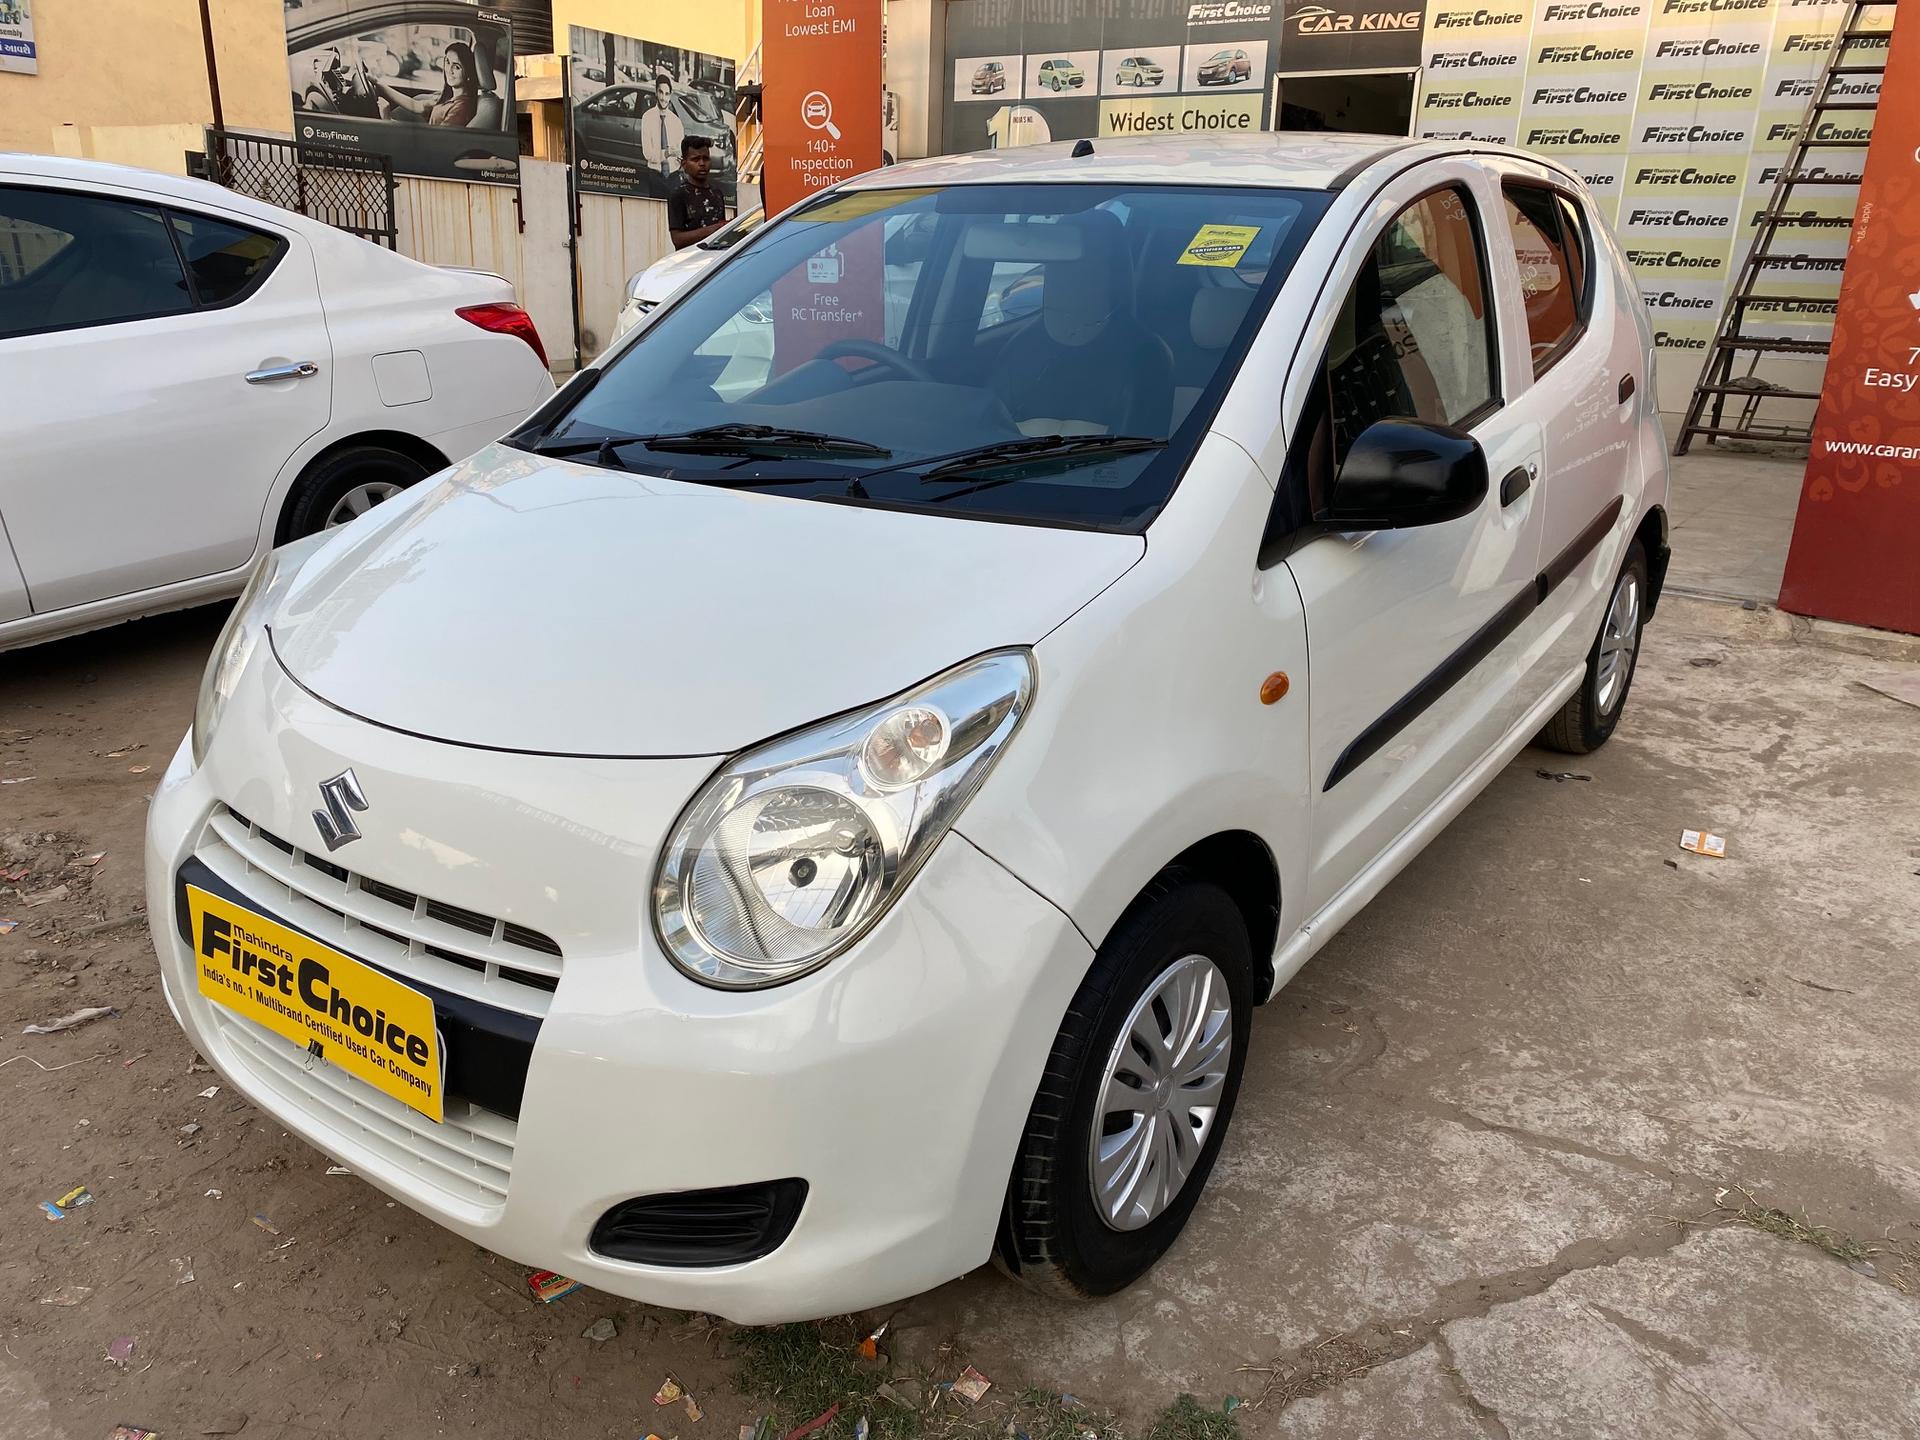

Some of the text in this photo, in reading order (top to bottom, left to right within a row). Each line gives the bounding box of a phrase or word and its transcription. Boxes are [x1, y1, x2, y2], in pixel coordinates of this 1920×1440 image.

[806, 6, 834, 18] Loan
[786, 19, 855, 36] Lowest EMI
[1298, 11, 1422, 33] CAR KING
[1110, 109, 1250, 132] Widest Choice
[316, 129, 359, 142] EasyFinance
[807, 140, 836, 152] 140+
[589, 162, 636, 174] EasyDocumentation
[791, 157, 853, 172] Inspection
[804, 174, 841, 186] Points
[814, 294, 839, 306] Free
[792, 308, 807, 320] RC
[1864, 368, 1919, 392] Easy
[203, 964, 432, 1097] India's no. 1 Multibrand Certified Used Car Company
